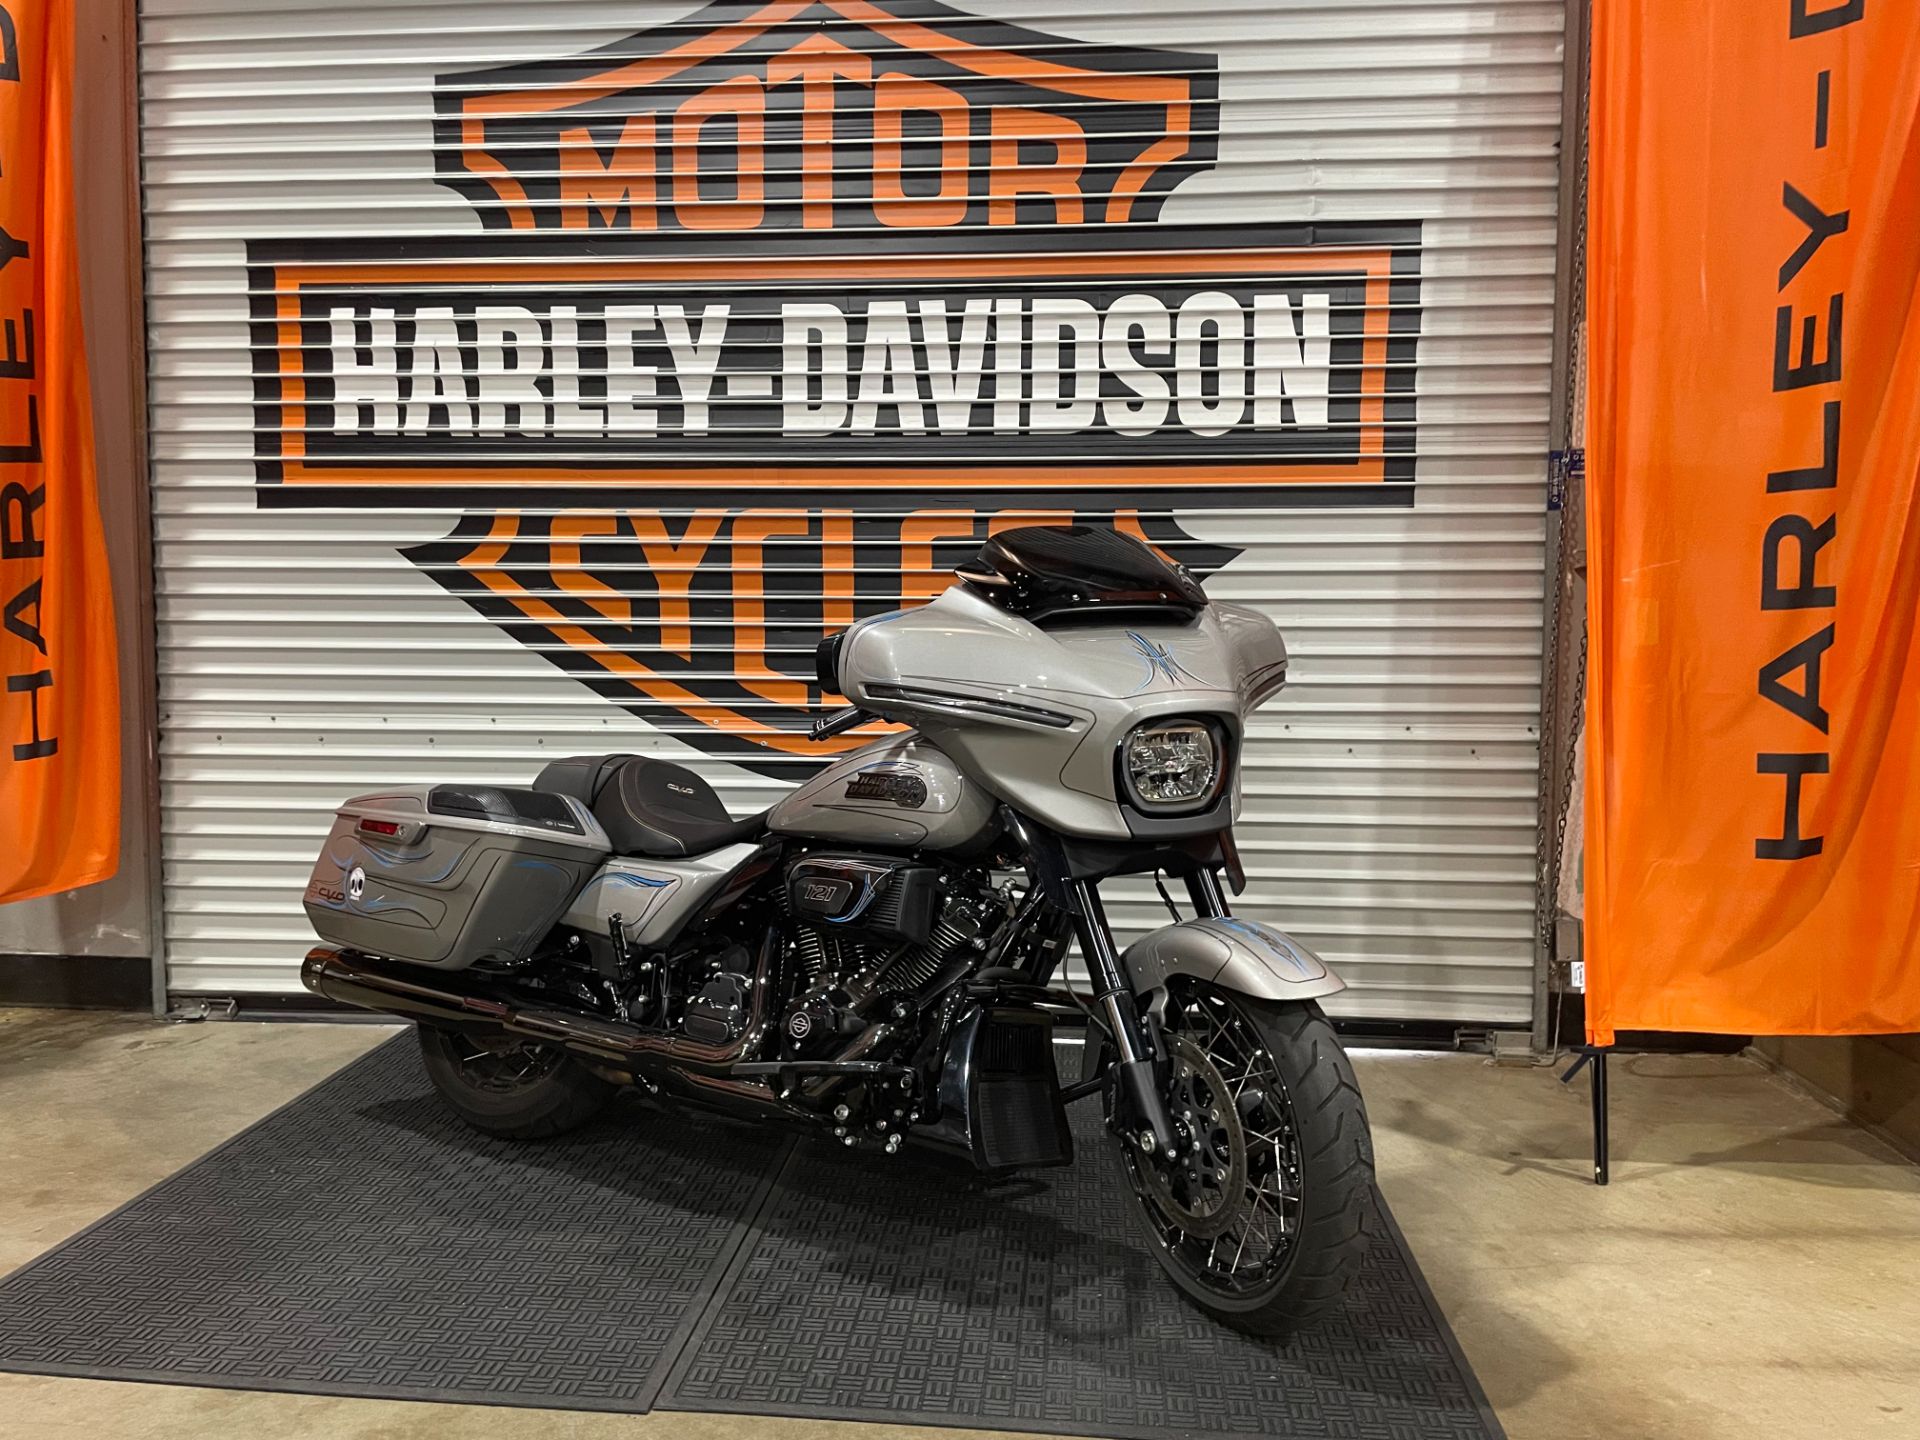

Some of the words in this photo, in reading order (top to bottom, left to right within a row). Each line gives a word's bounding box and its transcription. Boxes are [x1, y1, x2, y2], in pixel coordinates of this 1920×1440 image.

[559, 33, 1088, 230] MOTOR
[330, 291, 1331, 438] HARLEY-DAVIDSON
[318, 887, 346, 901] CVO
[804, 884, 838, 901] 121
